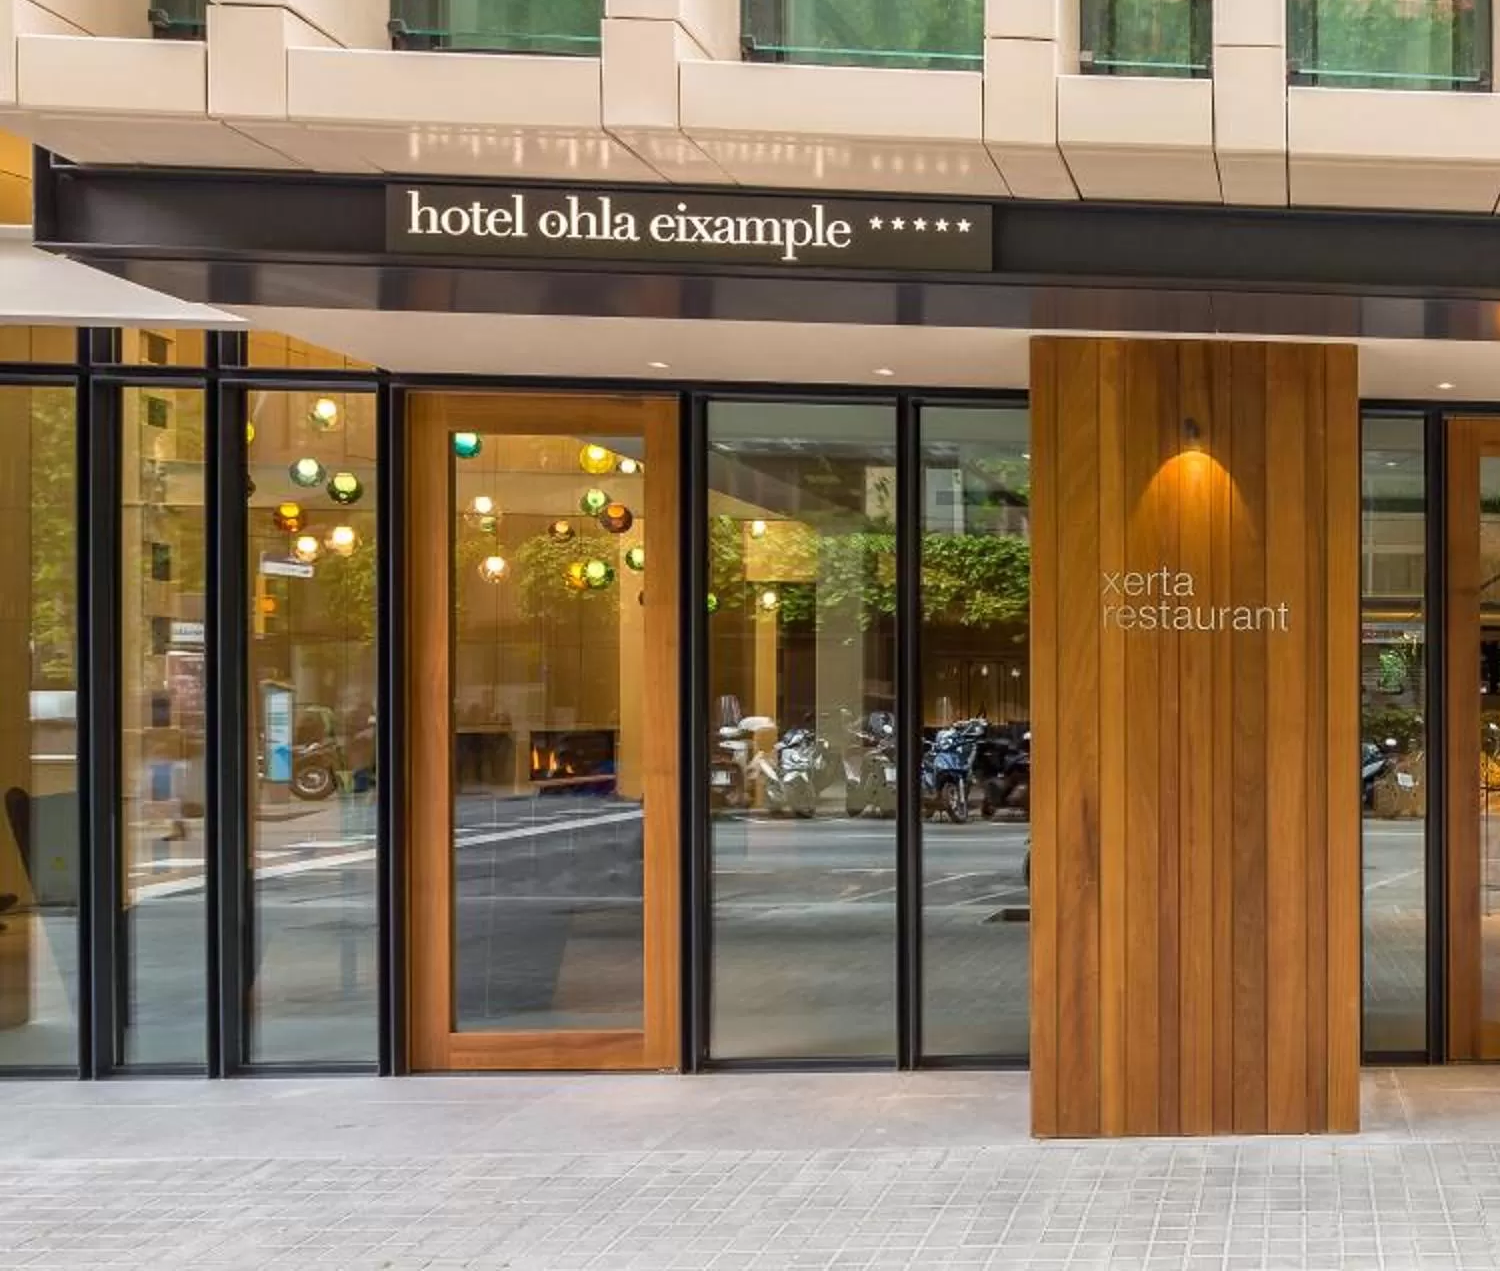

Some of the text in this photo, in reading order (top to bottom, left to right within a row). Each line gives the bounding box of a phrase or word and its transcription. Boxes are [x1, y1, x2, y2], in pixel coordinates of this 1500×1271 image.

[407, 190, 853, 261] hotel ohla eixample
[1103, 566, 1195, 597] xerta
[1103, 602, 1289, 632] restaurant
